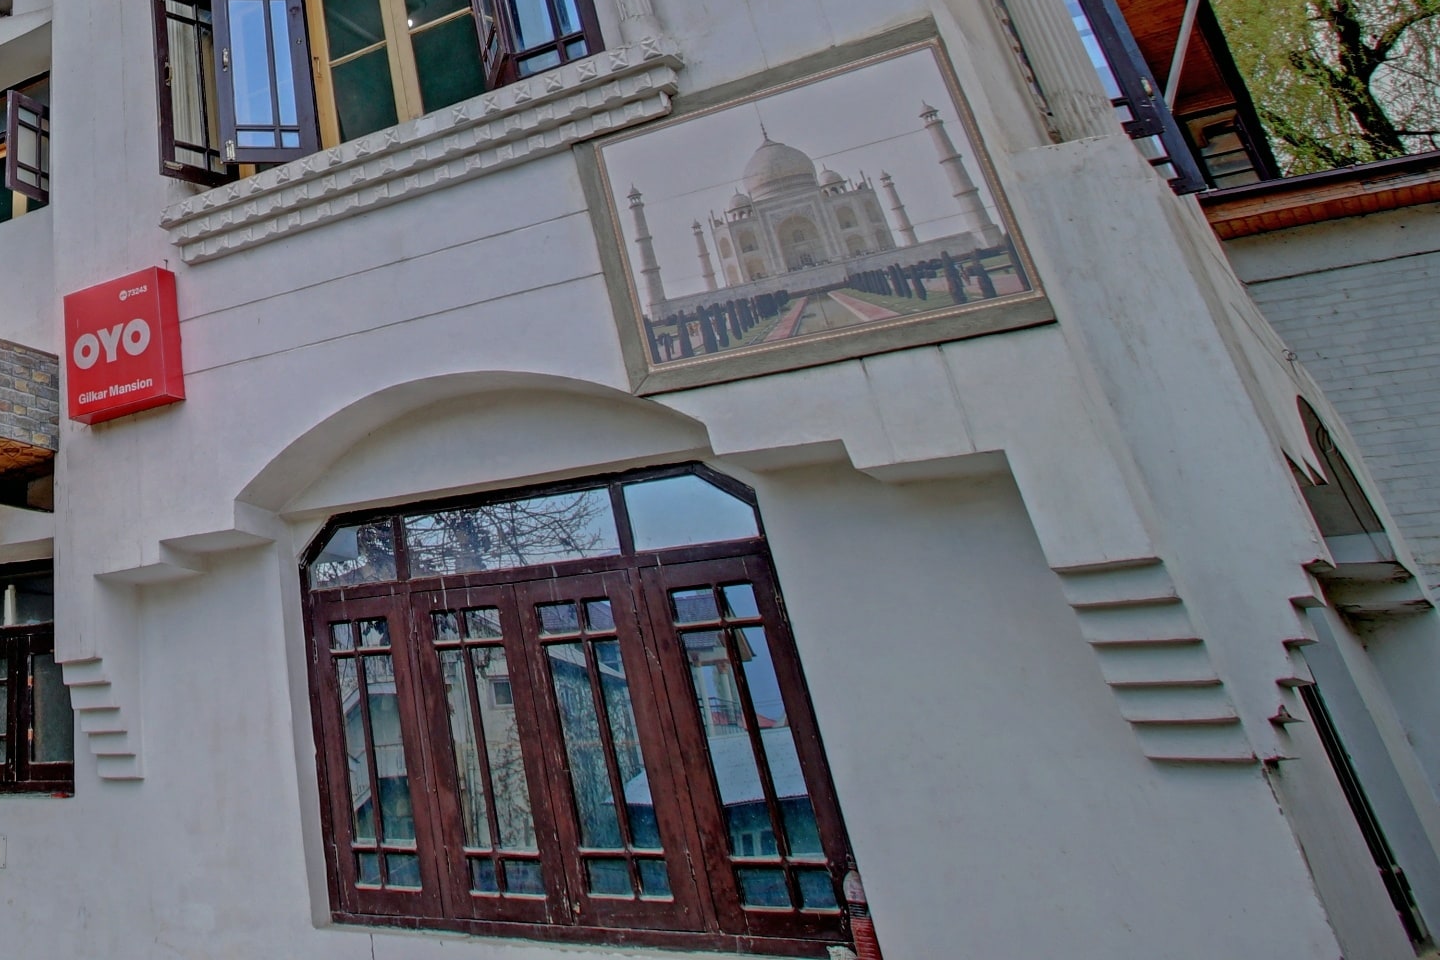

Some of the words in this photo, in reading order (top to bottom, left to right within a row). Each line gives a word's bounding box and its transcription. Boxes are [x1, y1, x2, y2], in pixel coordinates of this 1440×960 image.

[73, 318, 151, 370] OYO
[78, 388, 108, 405] Gilkar
[109, 378, 153, 397] Mansion
